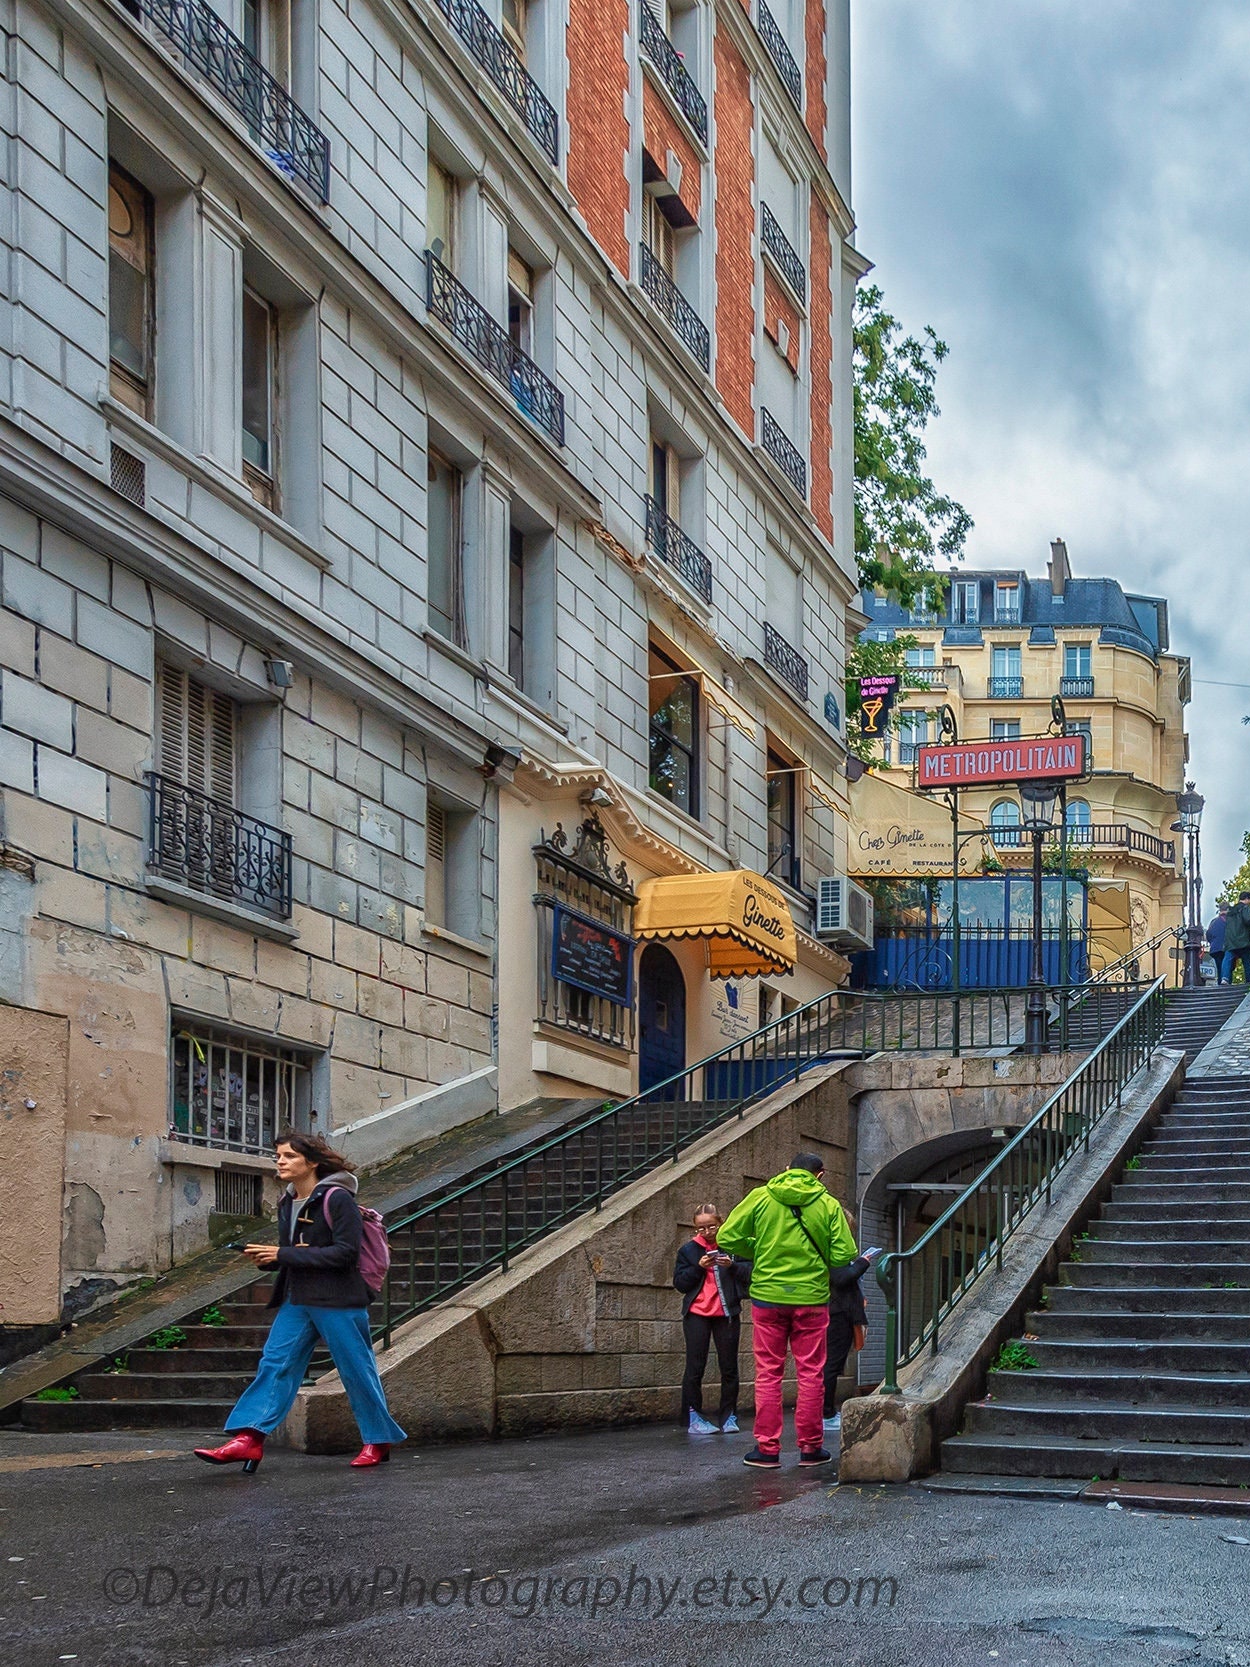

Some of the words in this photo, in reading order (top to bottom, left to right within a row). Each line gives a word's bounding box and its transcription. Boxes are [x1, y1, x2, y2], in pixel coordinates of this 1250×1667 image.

[860, 677, 871, 686] Les
[871, 675, 896, 686] Dessous
[860, 687, 869, 697] de
[925, 744, 1077, 778] METROPOLITAIN
[858, 830, 885, 851] Chez
[886, 825, 925, 850] Ginette
[742, 876, 753, 889] LES
[743, 894, 786, 941] Ginette
